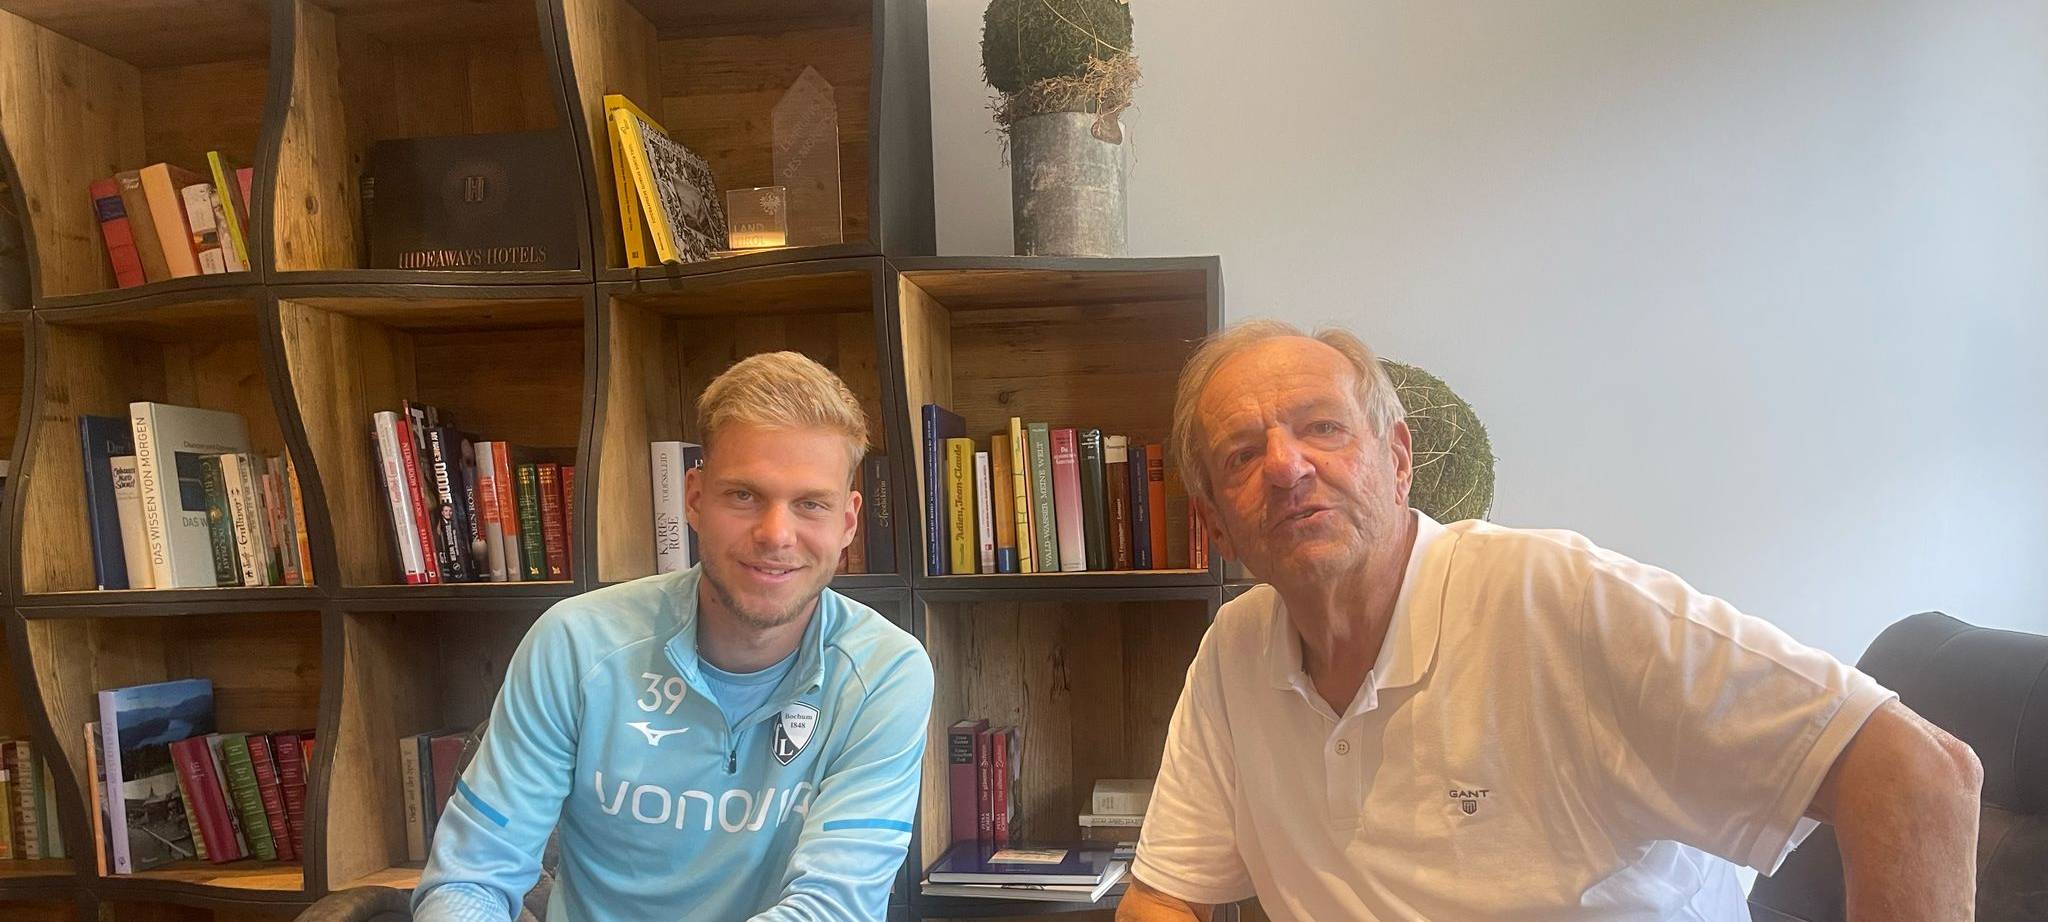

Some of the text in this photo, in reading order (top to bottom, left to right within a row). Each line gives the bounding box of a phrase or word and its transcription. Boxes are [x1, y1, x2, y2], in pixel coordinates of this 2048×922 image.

[733, 223, 766, 233] LAND
[734, 235, 767, 247] TIROL
[399, 246, 547, 269] HIDEAWAYS HOTELS
[1036, 441, 1046, 467] WELT
[136, 417, 164, 565] DAS WISSEN VON MORGEN
[434, 462, 453, 504] DODDIE
[1038, 469, 1048, 500] MEINE
[466, 485, 475, 511] ROSE
[183, 517, 198, 528] DAS
[656, 512, 669, 555] KAREN
[668, 517, 681, 550] ROSE
[637, 672, 687, 715] 39
[790, 721, 806, 729] 1848
[1449, 789, 1490, 798] GANT
